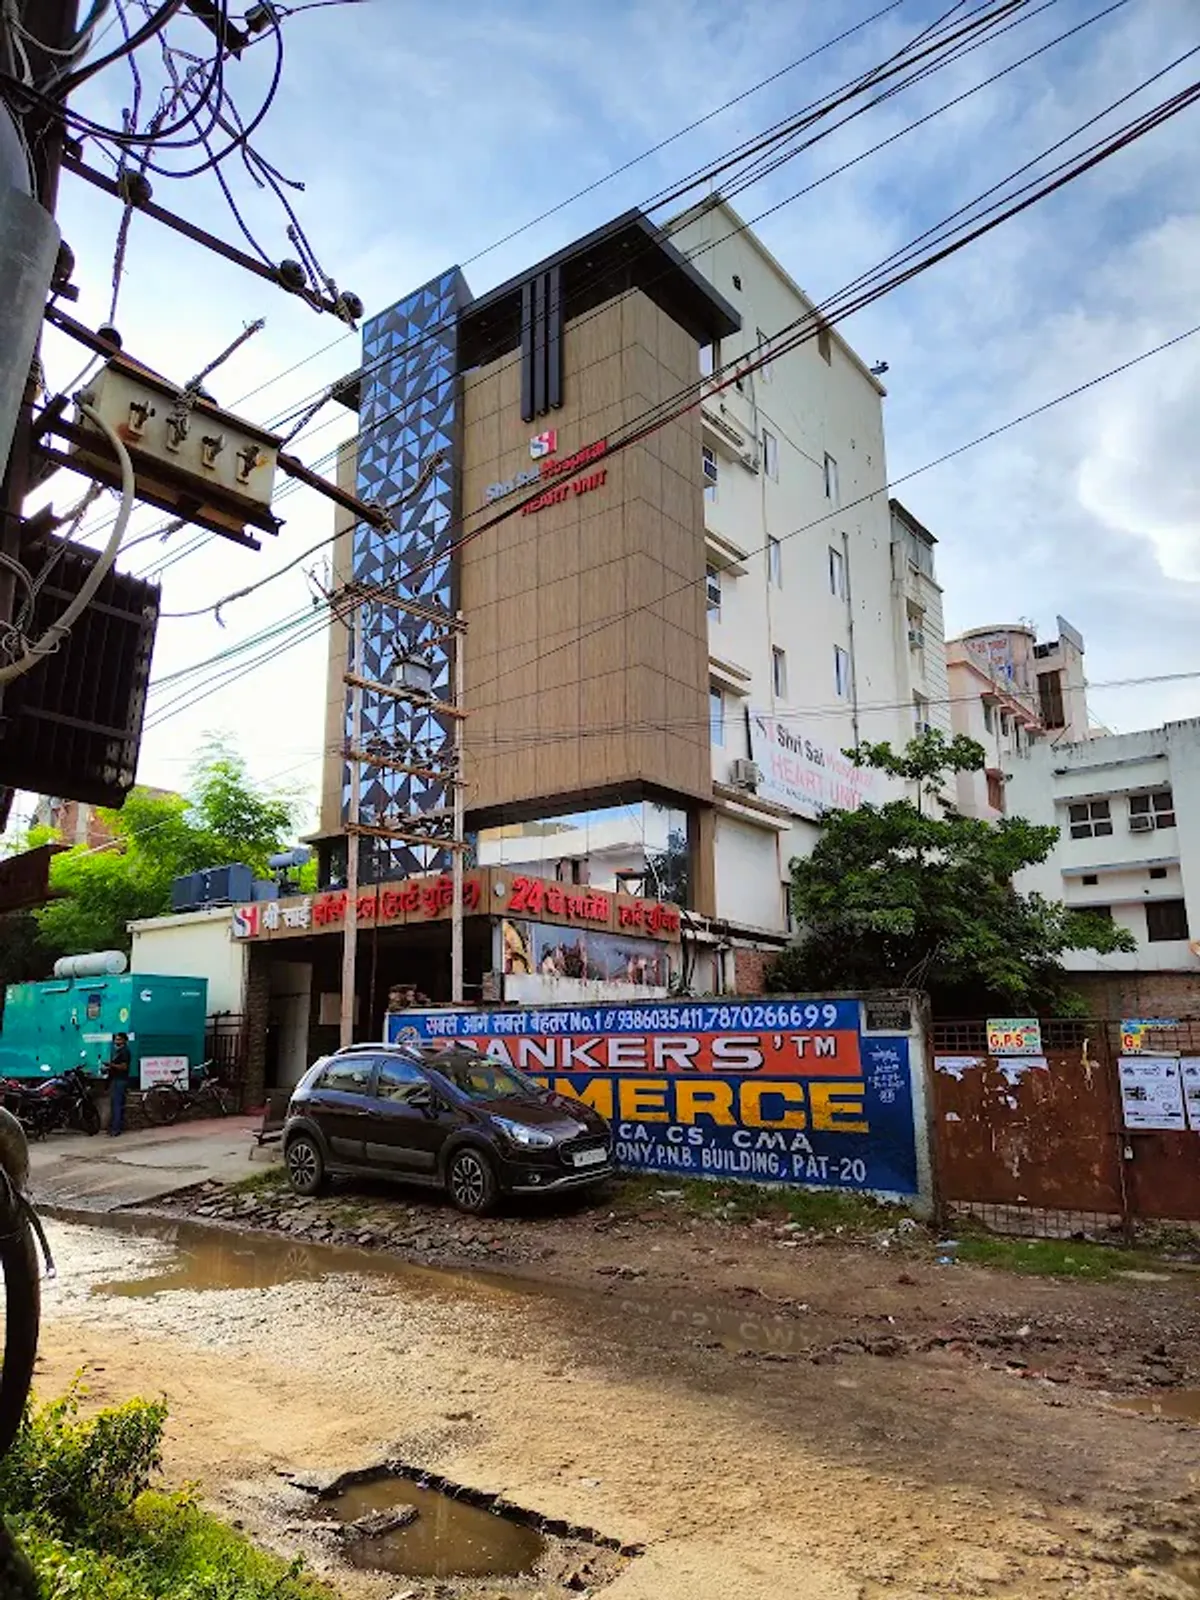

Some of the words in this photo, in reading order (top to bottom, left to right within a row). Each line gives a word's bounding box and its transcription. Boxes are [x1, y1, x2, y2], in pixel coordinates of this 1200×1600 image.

[776, 723, 803, 757] Shri
[804, 739, 826, 767] Sai
[771, 752, 824, 798] HEART
[507, 874, 545, 914] 24
[426, 1013, 459, 1035] सबसे
[462, 1012, 489, 1035] आगे
[492, 1010, 526, 1034] सबसे
[530, 1009, 570, 1035] बेहतर
[570, 1013, 601, 1032] No.1
[445, 1036, 782, 1071] ANKERS'
[534, 1077, 869, 1133] MERCE
[732, 1129, 813, 1154] CMA
[702, 1146, 788, 1178] BUILDING,
[793, 1153, 867, 1183] PAT-20
